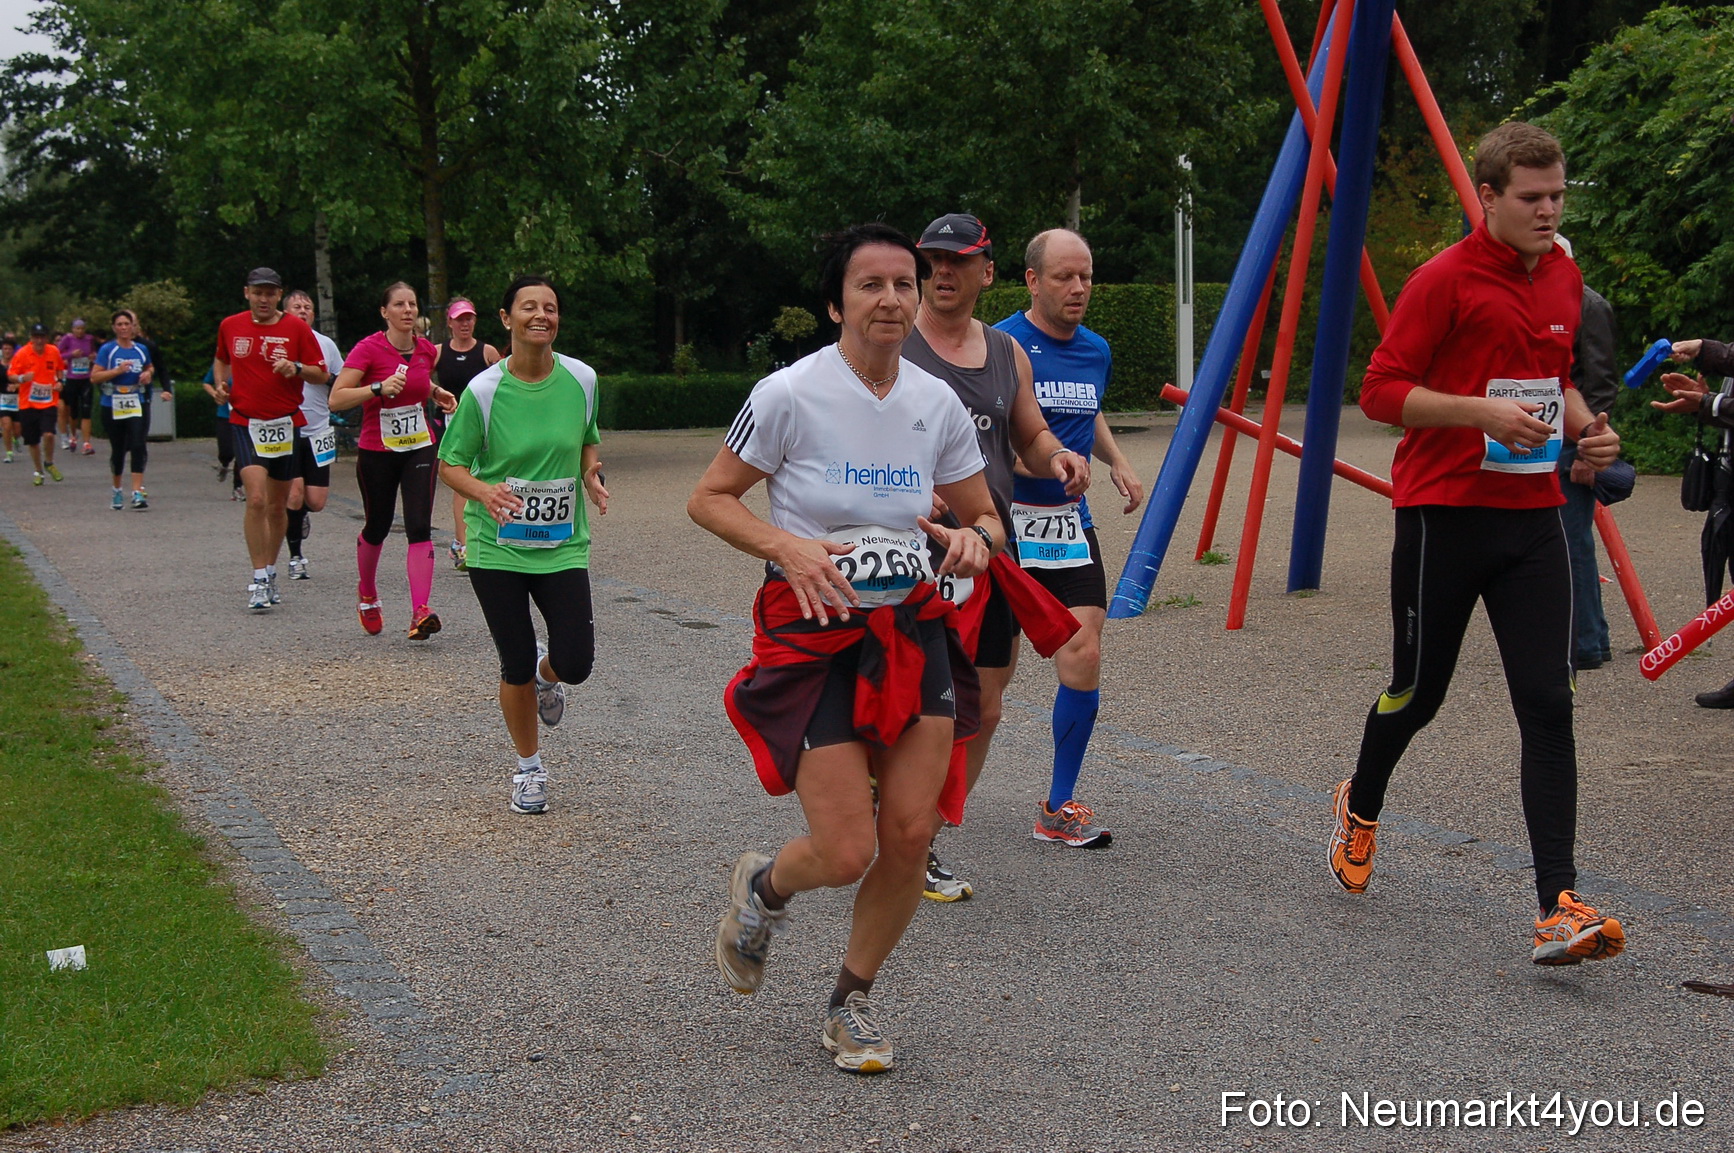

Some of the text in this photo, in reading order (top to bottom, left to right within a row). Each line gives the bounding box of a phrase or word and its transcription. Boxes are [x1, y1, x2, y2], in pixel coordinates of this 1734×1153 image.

[1034, 381, 1098, 400] HUBER
[1488, 387, 1557, 398] PARTL Neumarkt
[1051, 399, 1097, 408] TECHNOLOGY
[391, 414, 418, 436] 377
[258, 427, 287, 443] 326
[398, 437, 417, 446] Anika
[315, 434, 337, 453] 268
[844, 461, 921, 488] heinloth
[508, 484, 567, 494] ARTL Neumarkt
[873, 486, 922, 495] Immobilienverwaltung
[508, 494, 570, 522] 2835
[524, 527, 550, 539] Ilona
[1021, 515, 1078, 541] 2775
[862, 535, 909, 549] Neumarkt
[834, 548, 928, 583] 2268
